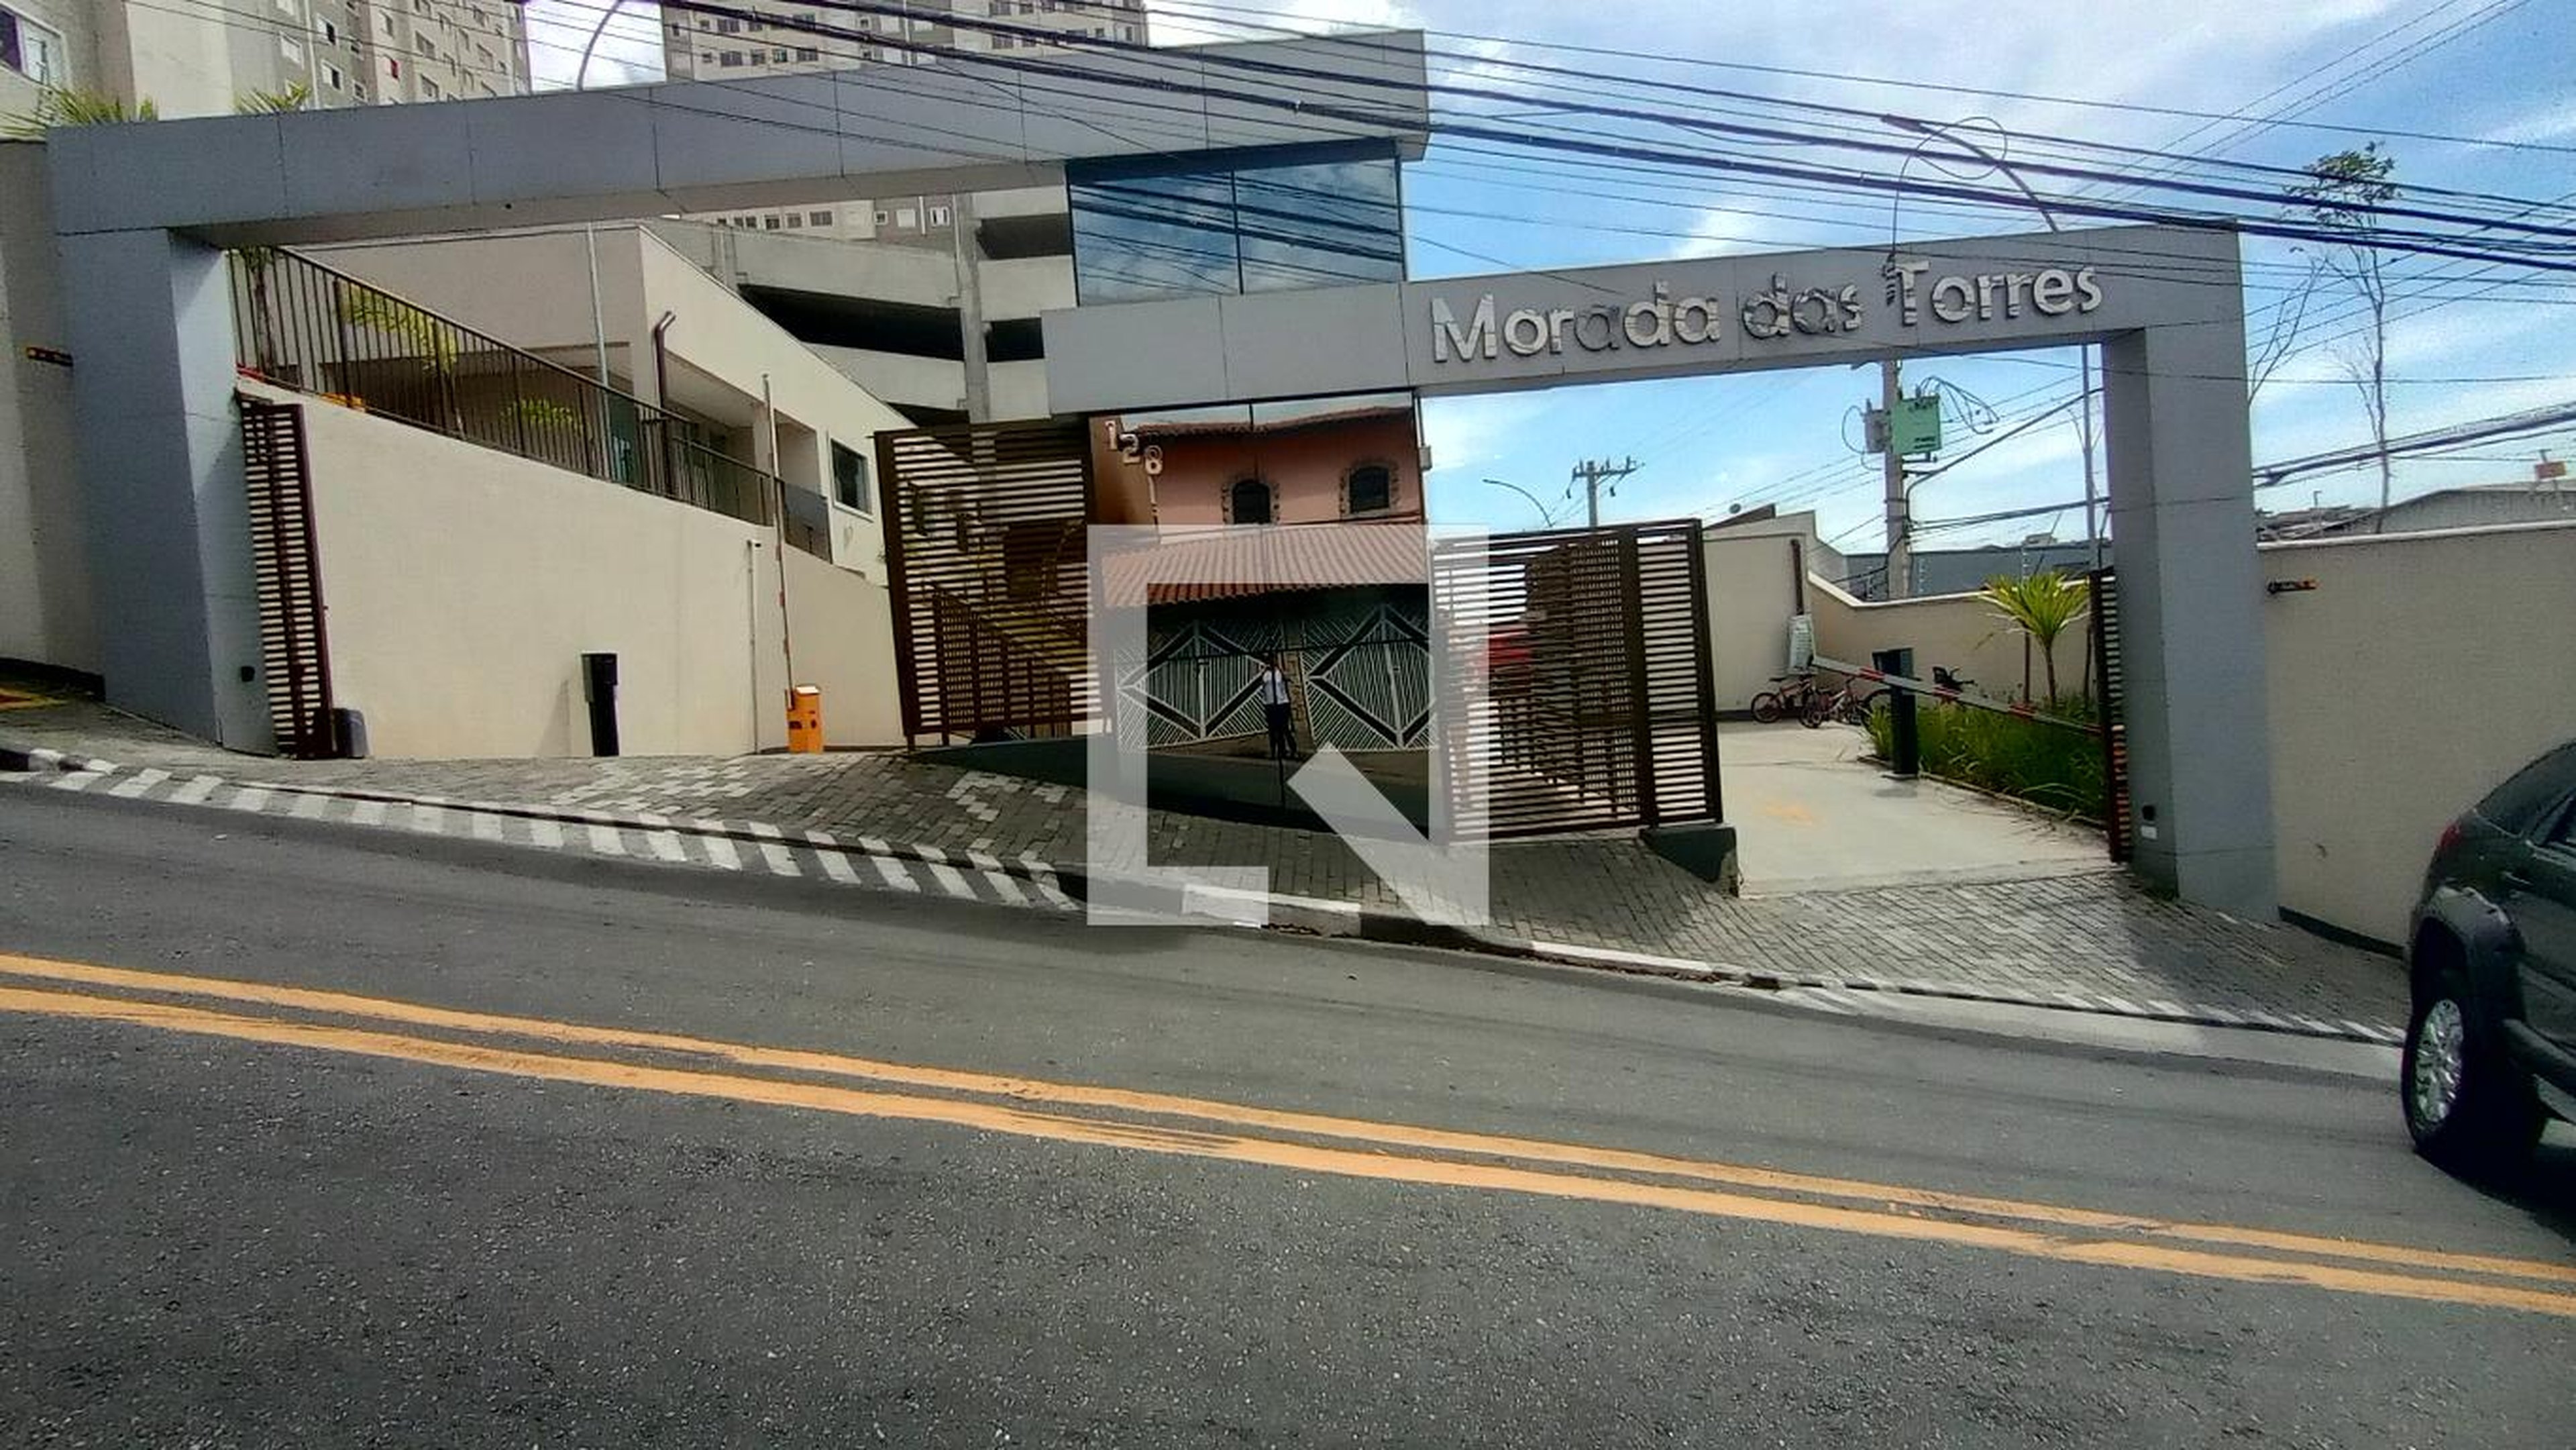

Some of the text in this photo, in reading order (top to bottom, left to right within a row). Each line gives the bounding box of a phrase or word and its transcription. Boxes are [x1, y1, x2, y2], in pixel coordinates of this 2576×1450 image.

[1432, 258, 2103, 362] Morada das Torres
